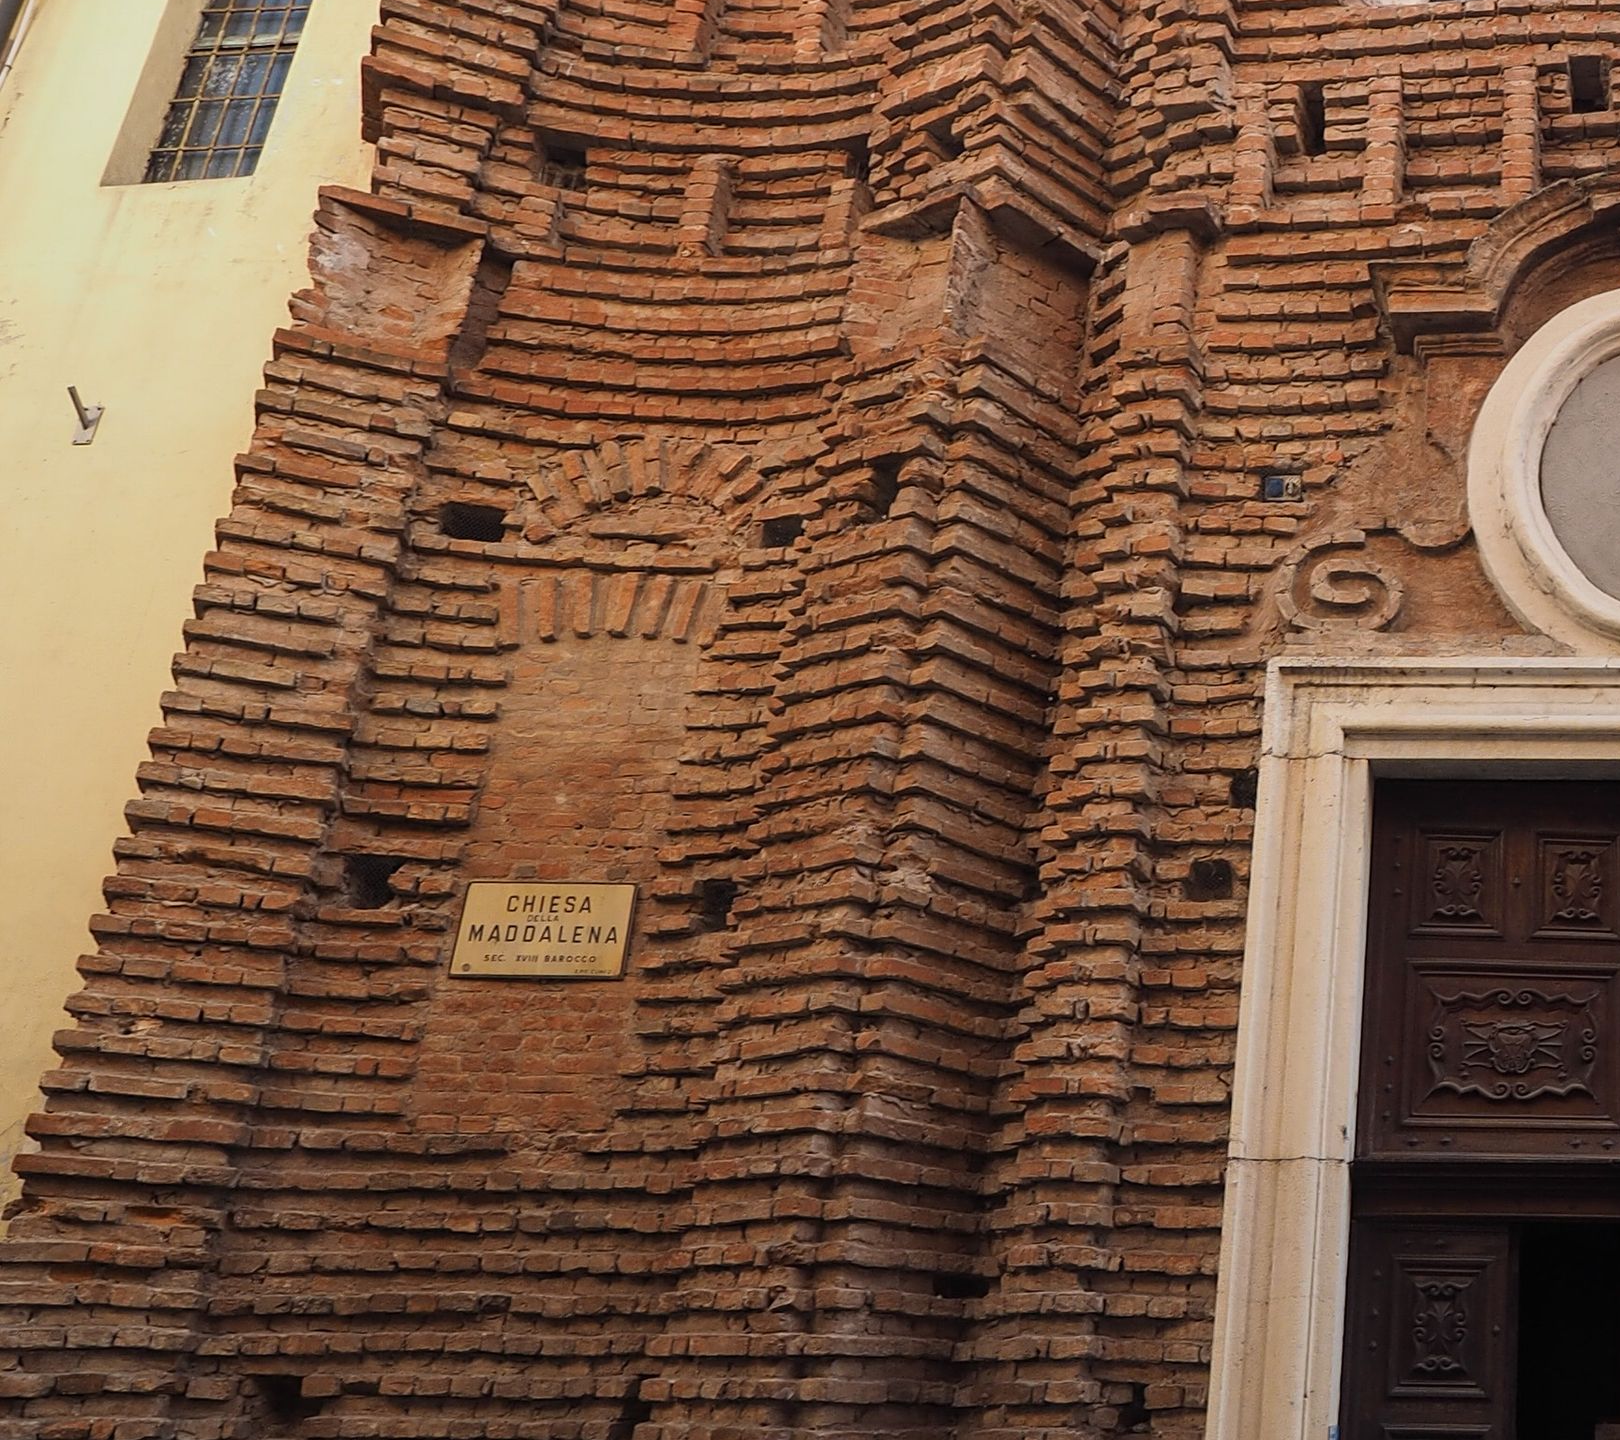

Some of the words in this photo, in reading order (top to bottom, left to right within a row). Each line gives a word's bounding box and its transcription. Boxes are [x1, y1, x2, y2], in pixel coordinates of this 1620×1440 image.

[506, 895, 592, 914] CHIESA
[526, 914, 560, 923] DELLA
[468, 924, 618, 944] MADDALENA
[483, 953, 506, 963] SEC.
[515, 954, 539, 964] XVIII
[544, 954, 597, 964] BAROCCO
